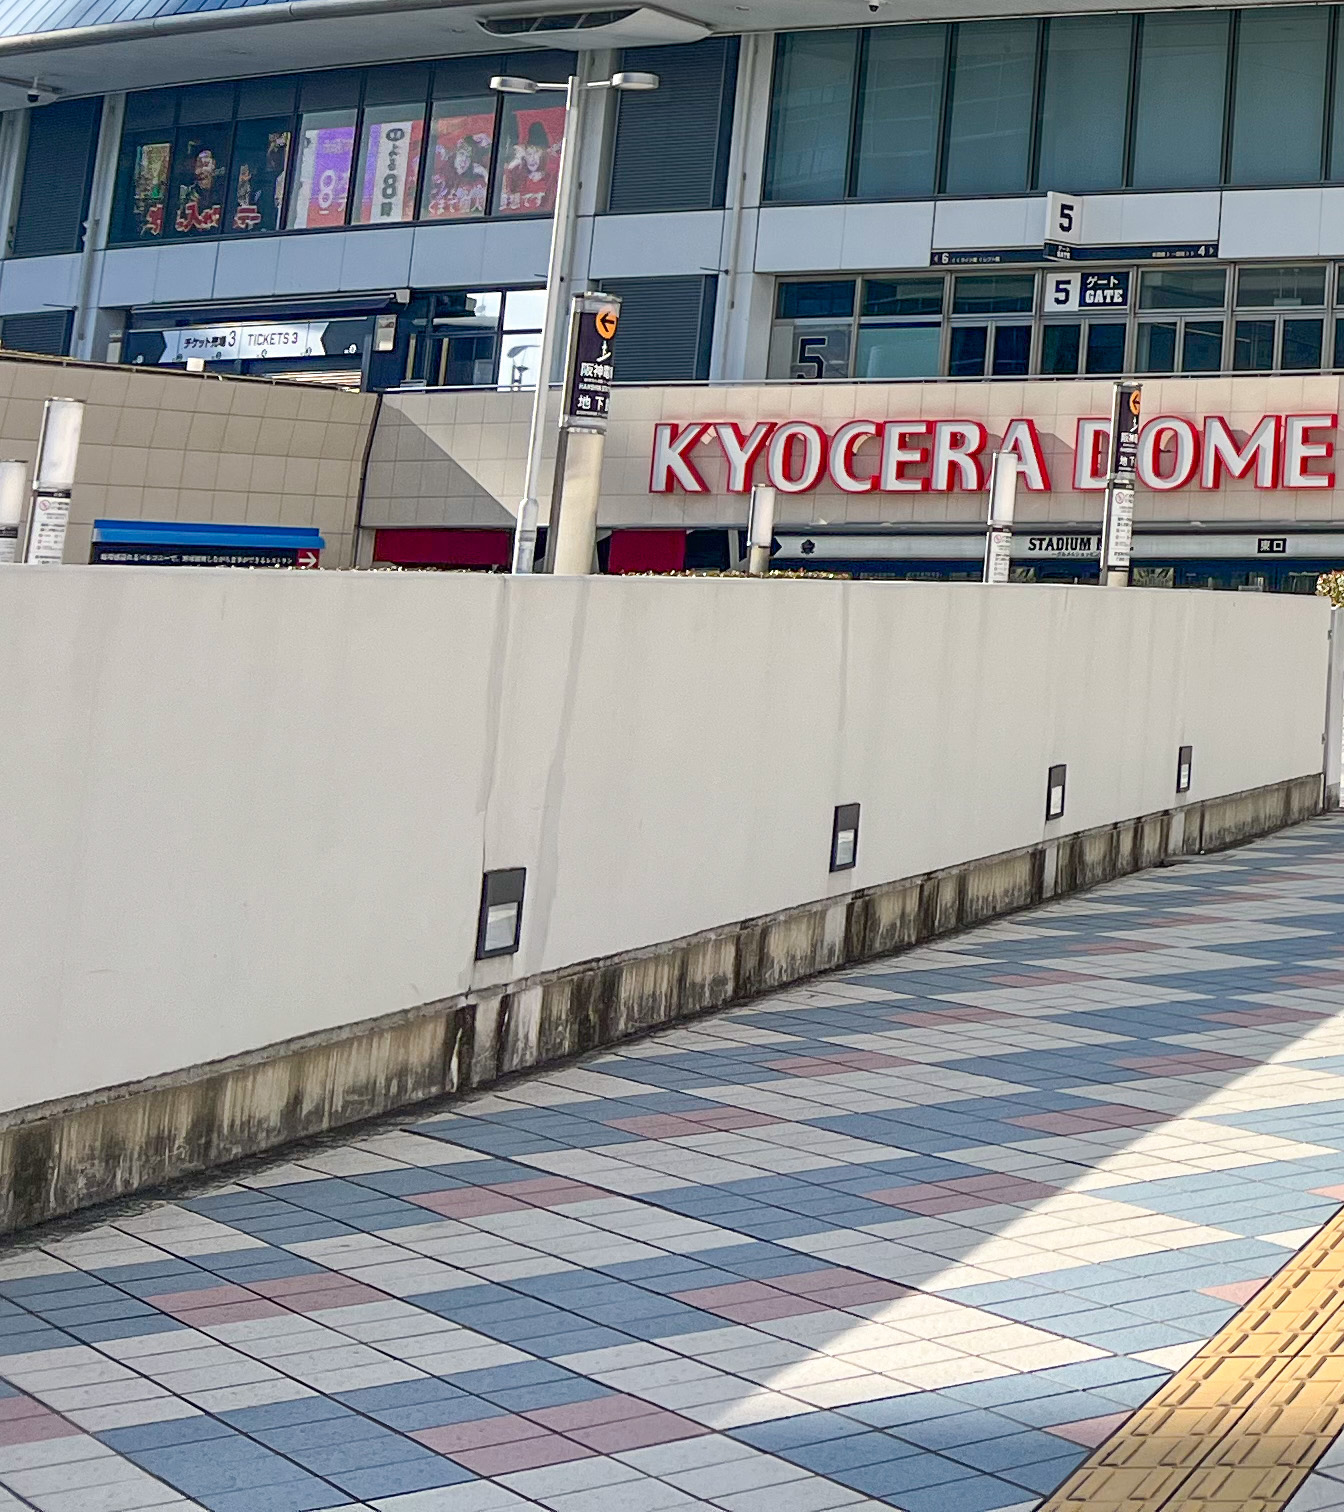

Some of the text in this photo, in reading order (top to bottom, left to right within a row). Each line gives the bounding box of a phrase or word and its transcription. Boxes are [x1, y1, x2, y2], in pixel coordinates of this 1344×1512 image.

[1058, 203, 1075, 233] 5
[941, 252, 950, 265] 6
[1197, 245, 1206, 257] 4
[1086, 274, 1119, 288] ゲート
[1053, 279, 1073, 305] 5
[1085, 289, 1123, 305] GATE
[228, 331, 237, 347] 3
[248, 333, 289, 347] TICKETS
[290, 332, 299, 345] 3
[796, 336, 828, 379] 5
[650, 417, 1051, 494] KYOCERA
[1071, 413, 1338, 493] DOME
[1028, 537, 1092, 552] STADIUM
[1260, 539, 1284, 552] 東口
